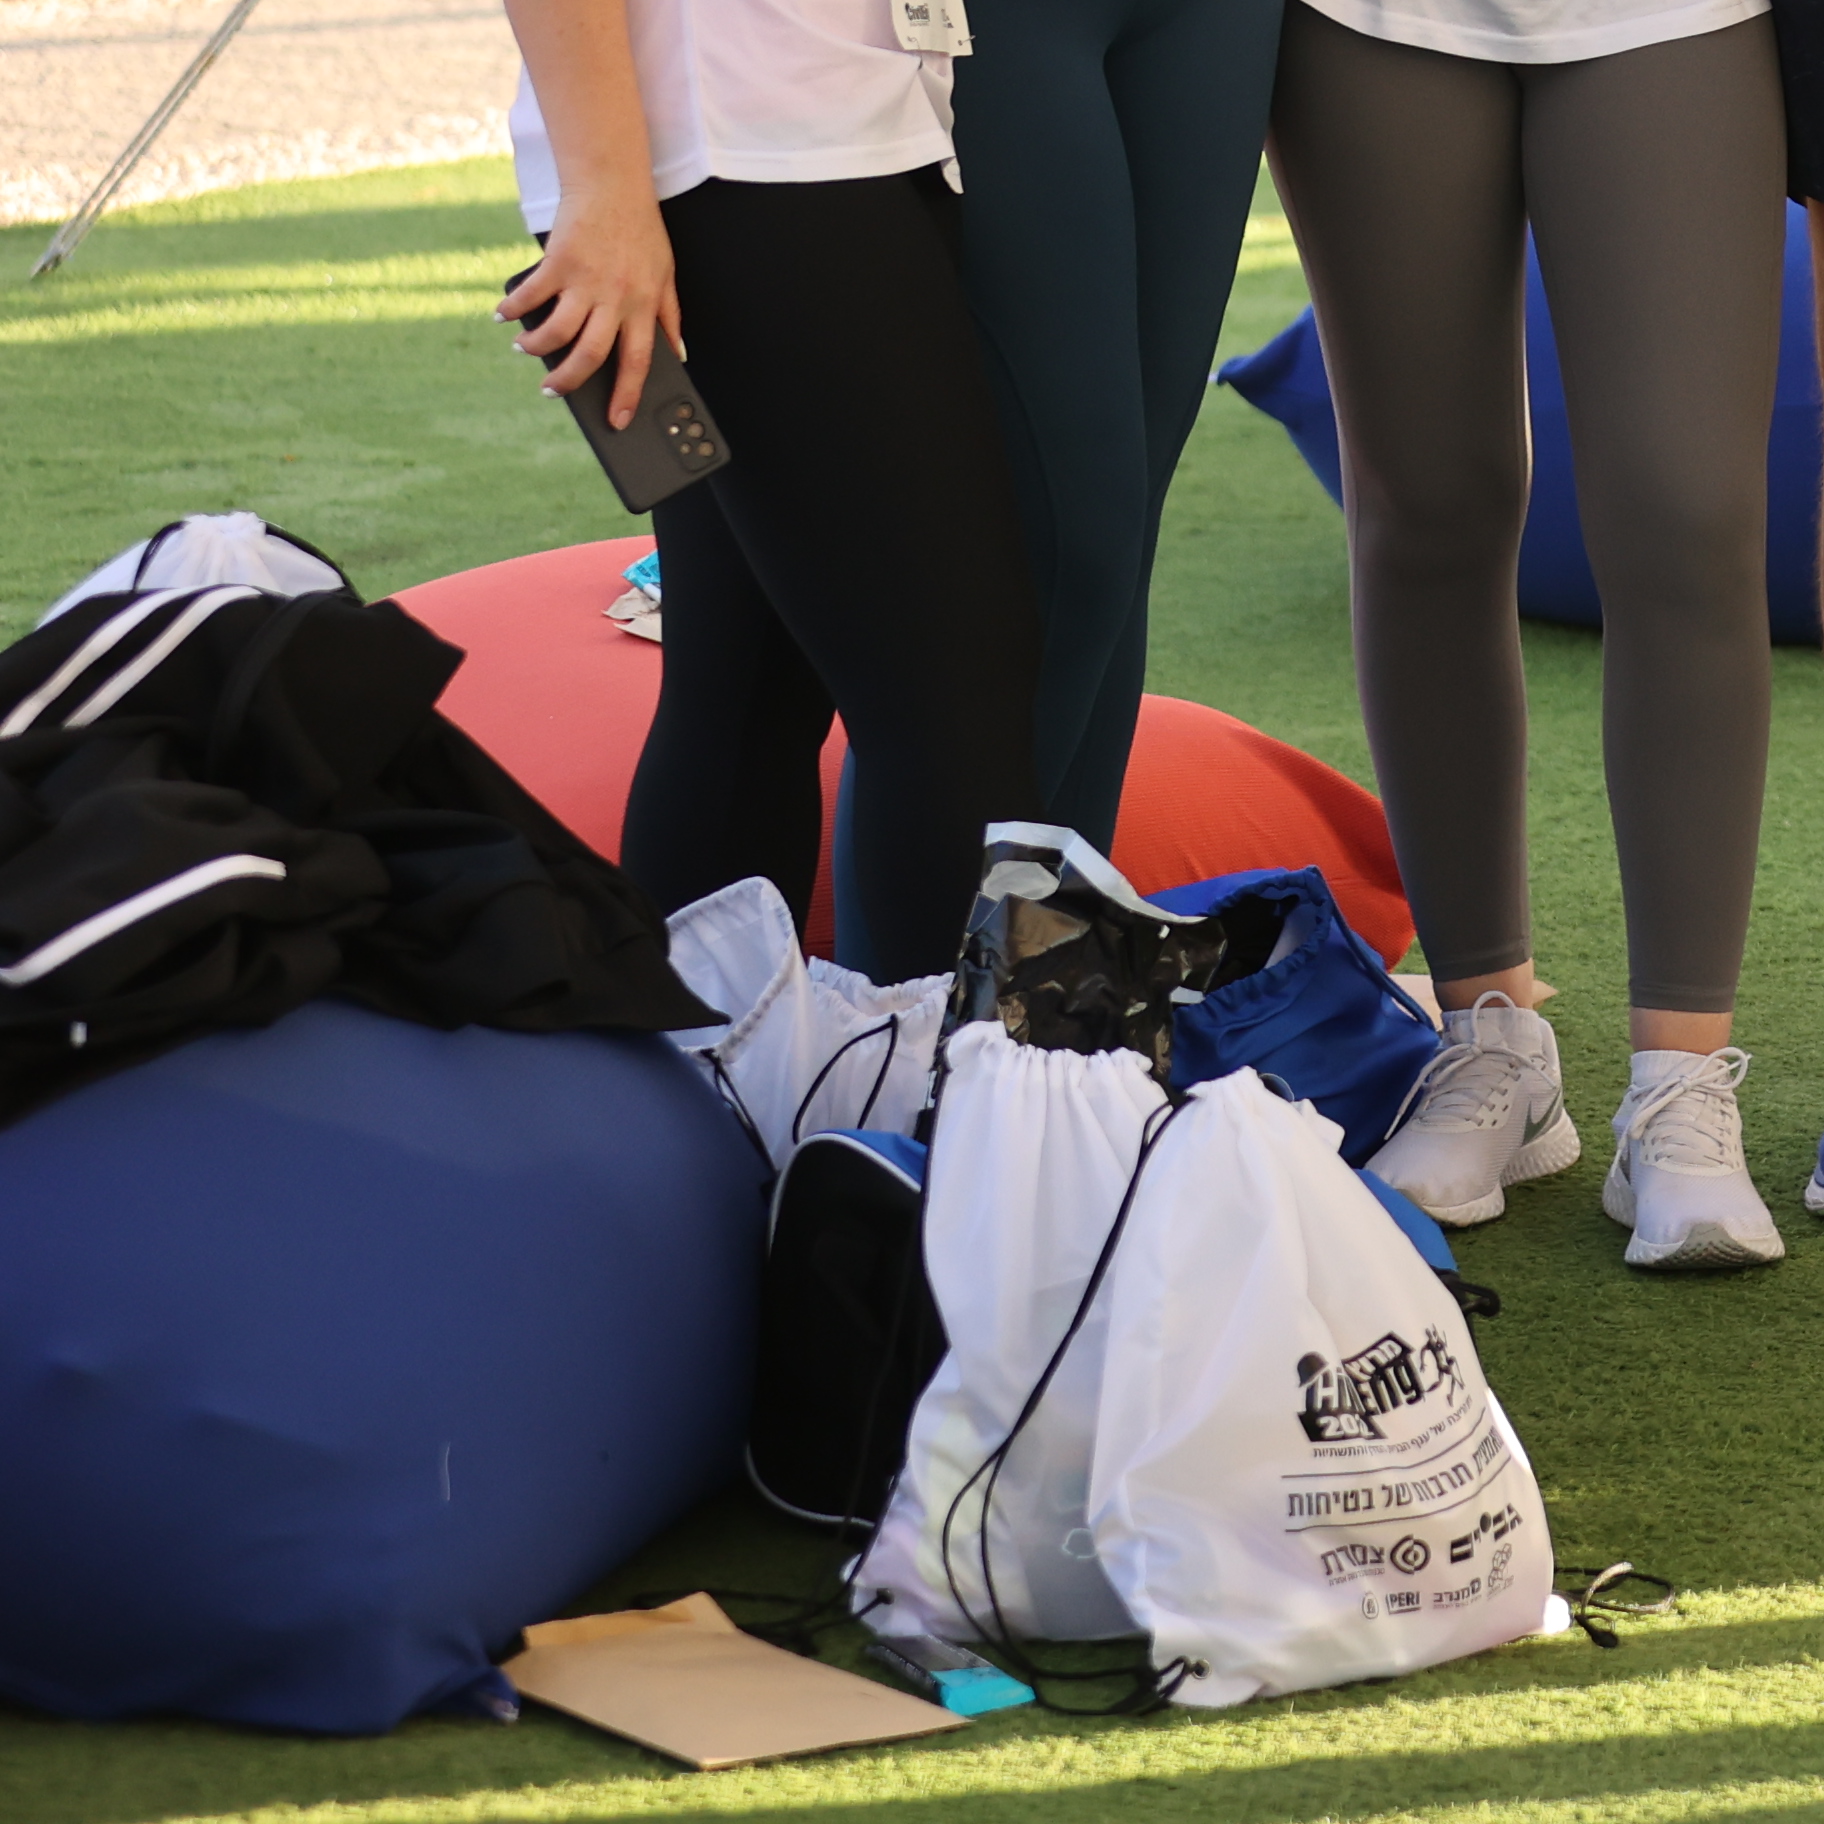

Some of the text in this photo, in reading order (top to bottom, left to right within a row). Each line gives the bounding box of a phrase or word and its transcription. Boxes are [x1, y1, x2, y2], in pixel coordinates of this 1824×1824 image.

[1287, 1487, 1376, 1518] בטיחות
[1381, 1482, 1414, 1507] של
[1389, 1591, 1421, 1608] PERI
